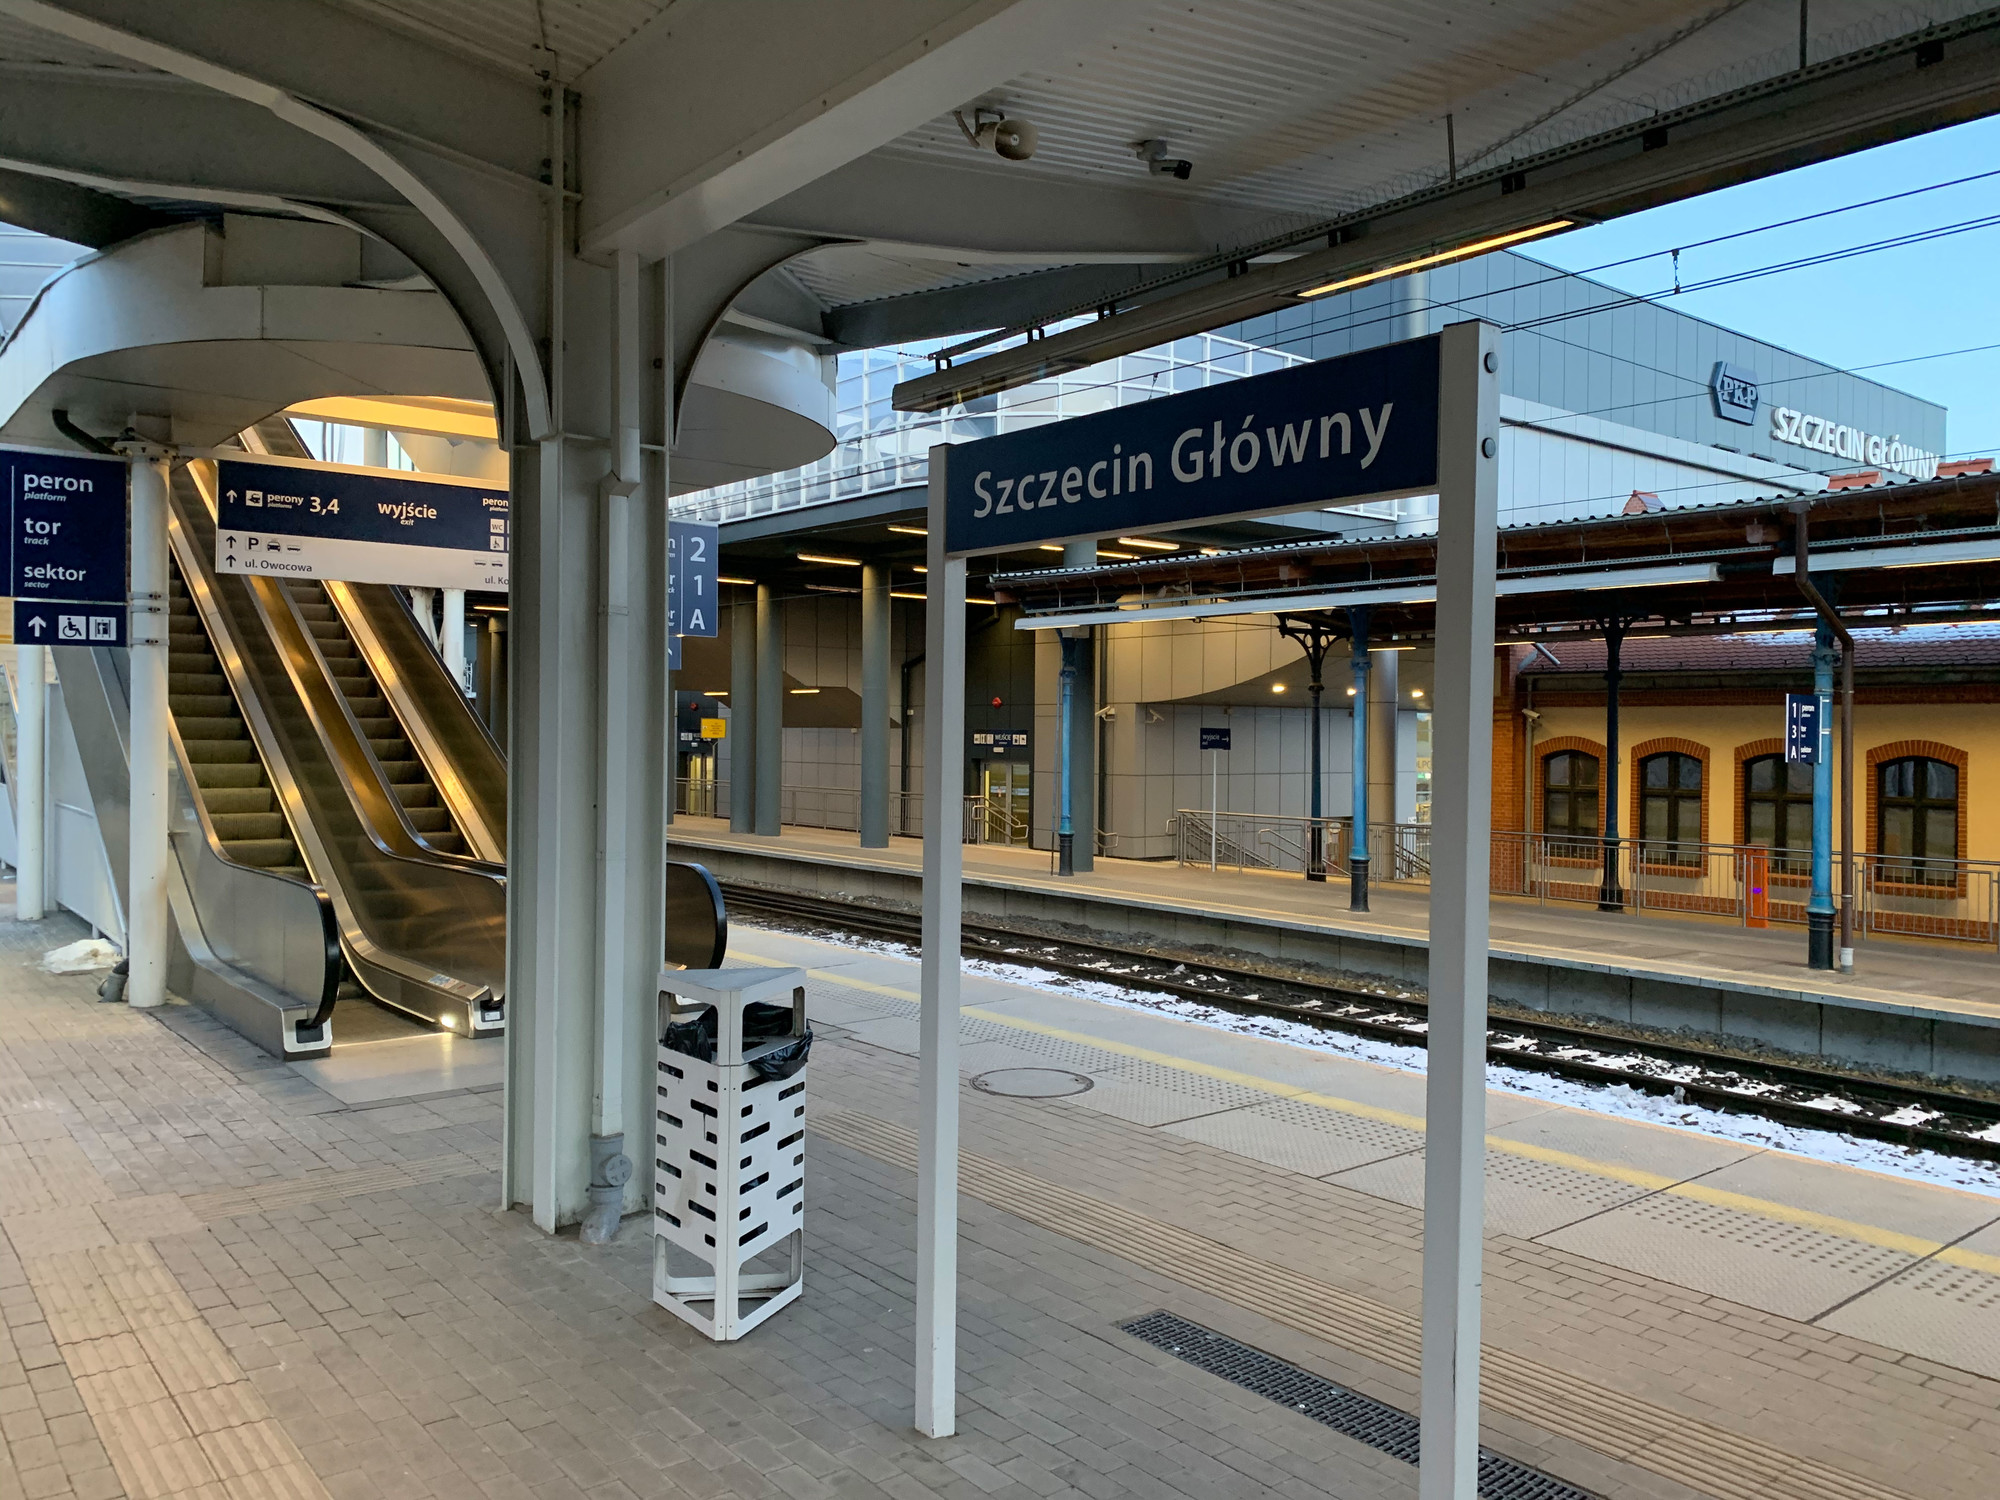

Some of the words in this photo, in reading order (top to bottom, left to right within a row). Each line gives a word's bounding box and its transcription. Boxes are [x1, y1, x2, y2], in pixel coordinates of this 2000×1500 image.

[1721, 376, 1758, 409] PKP
[1771, 406, 1866, 462] SZCZECIN
[1864, 434, 1940, 479] GŁÓWNY
[973, 443, 1154, 519] Szczecin
[1171, 402, 1394, 483] Główny
[23, 473, 94, 492] peron
[24, 492, 67, 502] platform
[267, 494, 304, 506] perony
[309, 496, 340, 515] 3,4
[377, 502, 437, 519] wyjście
[24, 517, 62, 535] tor
[24, 536, 49, 545] track
[248, 537, 260, 550] P
[689, 536, 706, 562] 2
[23, 564, 87, 581] sektor
[245, 559, 258, 569] ul.
[260, 560, 313, 572] Owocowa
[24, 581, 50, 589] sector
[484, 575, 496, 584] ul.
[693, 574, 703, 596] 1
[689, 608, 706, 630] A
[1792, 702, 1797, 718] 1
[1791, 725, 1797, 739] 3
[1790, 745, 1797, 759] A
